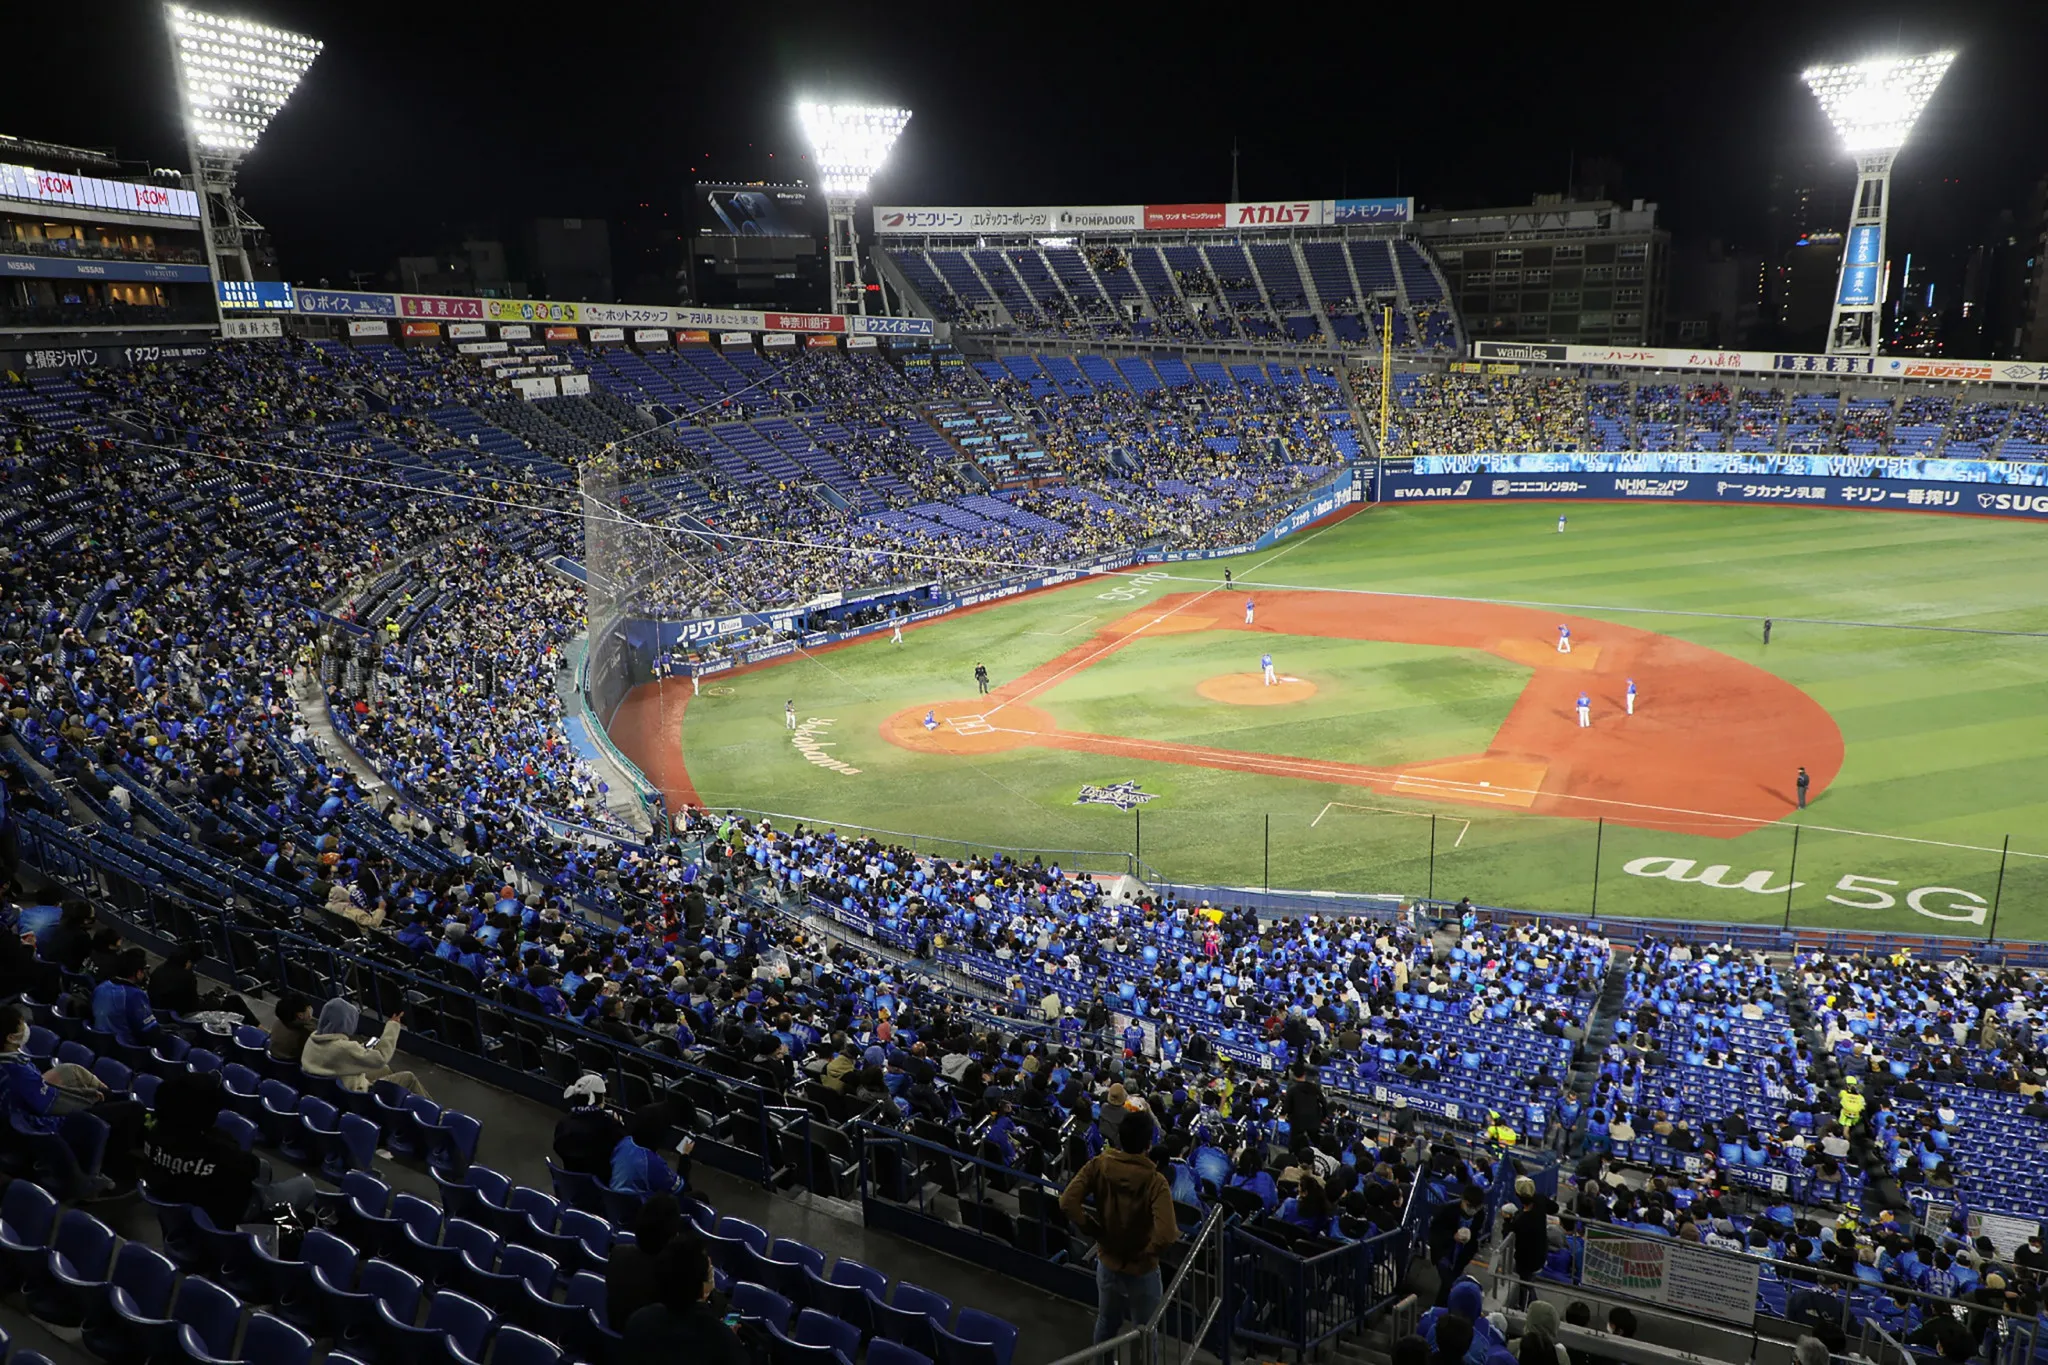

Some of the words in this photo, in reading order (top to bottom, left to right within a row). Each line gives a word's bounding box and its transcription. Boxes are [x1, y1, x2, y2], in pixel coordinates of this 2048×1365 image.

[37, 175, 73, 195] J:COM
[135, 189, 168, 206] J:COM
[1239, 203, 1310, 223] オカムラ
[1345, 203, 1407, 218] メモワール
[906, 213, 963, 227] サニクリーン
[1075, 214, 1135, 226] POMPADOUR
[7, 261, 36, 271] NISSAN
[77, 265, 105, 275] NISSAN
[317, 295, 352, 311] ボイス
[420, 301, 479, 315] 東京バス
[605, 309, 669, 322] ホットスタッフ
[780, 315, 831, 330] 神奈川銀行
[868, 318, 931, 333] ウスイホーム
[34, 349, 98, 369] 損保ジャパン
[135, 346, 159, 361] タスク
[1496, 346, 1548, 359] wamiles
[1394, 488, 1424, 498] EVA
[1424, 487, 1452, 497] AIR
[1509, 481, 1587, 493] ニコニコレンタカー
[1743, 485, 1826, 499] タカナシ乳業
[1841, 486, 1886, 502] キリン
[1889, 488, 1960, 506] 一番搾り
[676, 619, 716, 643] ノジマ
[1622, 856, 1805, 895] au
[1825, 874, 1989, 926] 5G
[1243, 1051, 1256, 1061] 151
[1425, 1100, 1439, 1109] 171
[153, 1146, 217, 1176] Angels
[1746, 1171, 1765, 1182] 191
